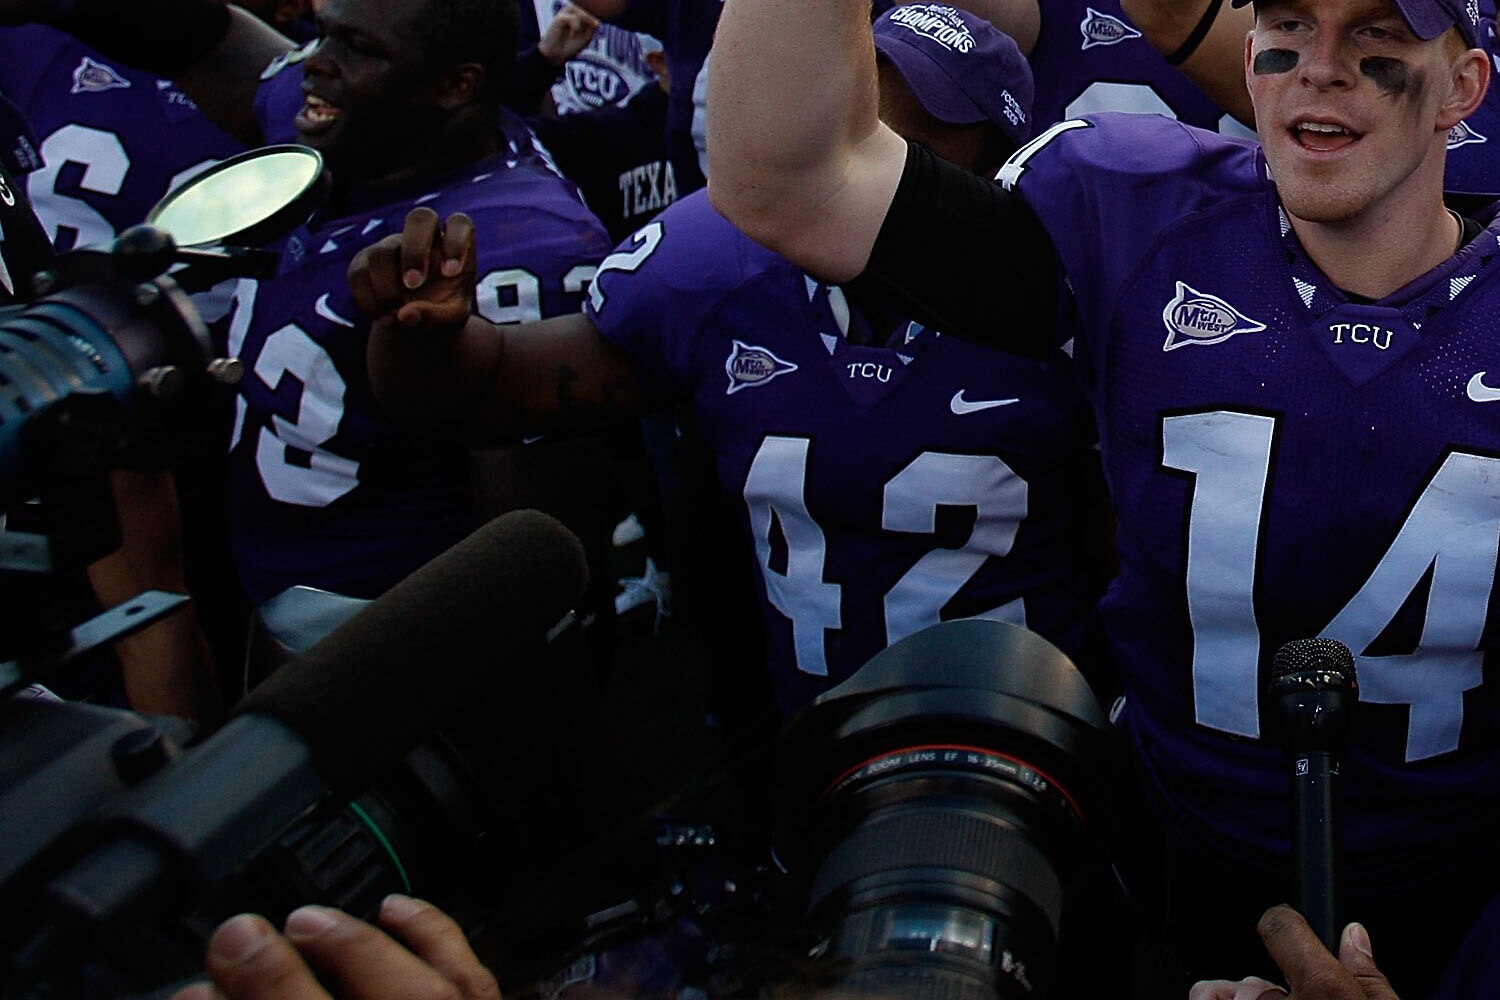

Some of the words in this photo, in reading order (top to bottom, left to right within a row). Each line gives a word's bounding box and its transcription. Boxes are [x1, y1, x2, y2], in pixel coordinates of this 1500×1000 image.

[890, 6, 973, 54] CHAMPIONS
[571, 63, 621, 101] TCU
[1177, 306, 1222, 327] Mtn.
[1197, 322, 1228, 333] WEST
[1330, 323, 1394, 350] TCU
[847, 362, 893, 383] TCU
[743, 434, 1030, 677] 42
[908, 751, 936, 764] LENS
[943, 752, 959, 762] EF
